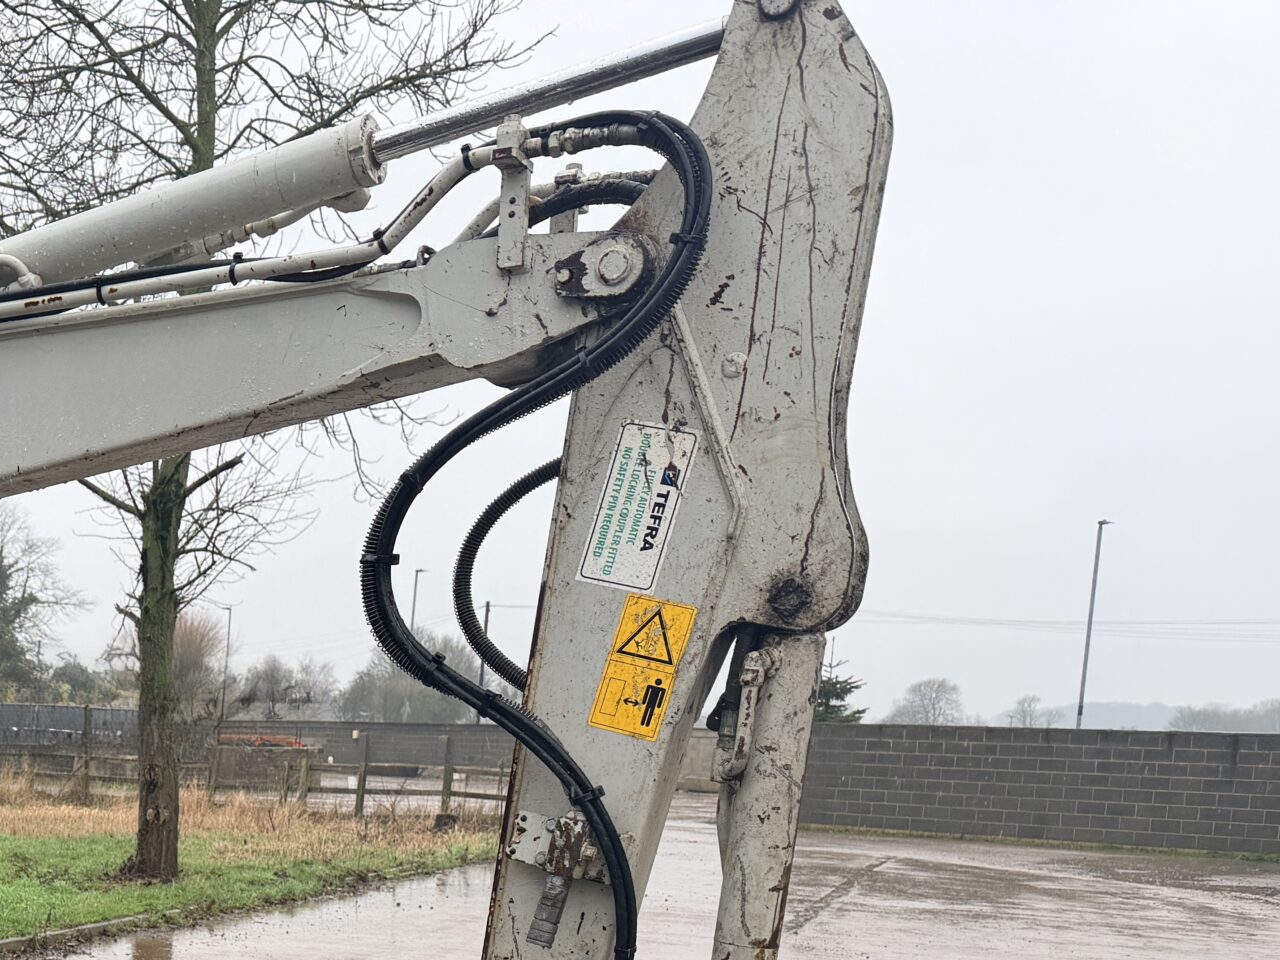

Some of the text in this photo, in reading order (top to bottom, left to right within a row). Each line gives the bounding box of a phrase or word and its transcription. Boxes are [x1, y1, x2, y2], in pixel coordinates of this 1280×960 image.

[593, 447, 633, 557] NO SAFETY PIN REQUIRED
[603, 433, 652, 575] DOUBLE LOCKING COUPLER FITTED
[626, 497, 647, 545] AUTOMATIC
[640, 490, 671, 551] TEFRA
